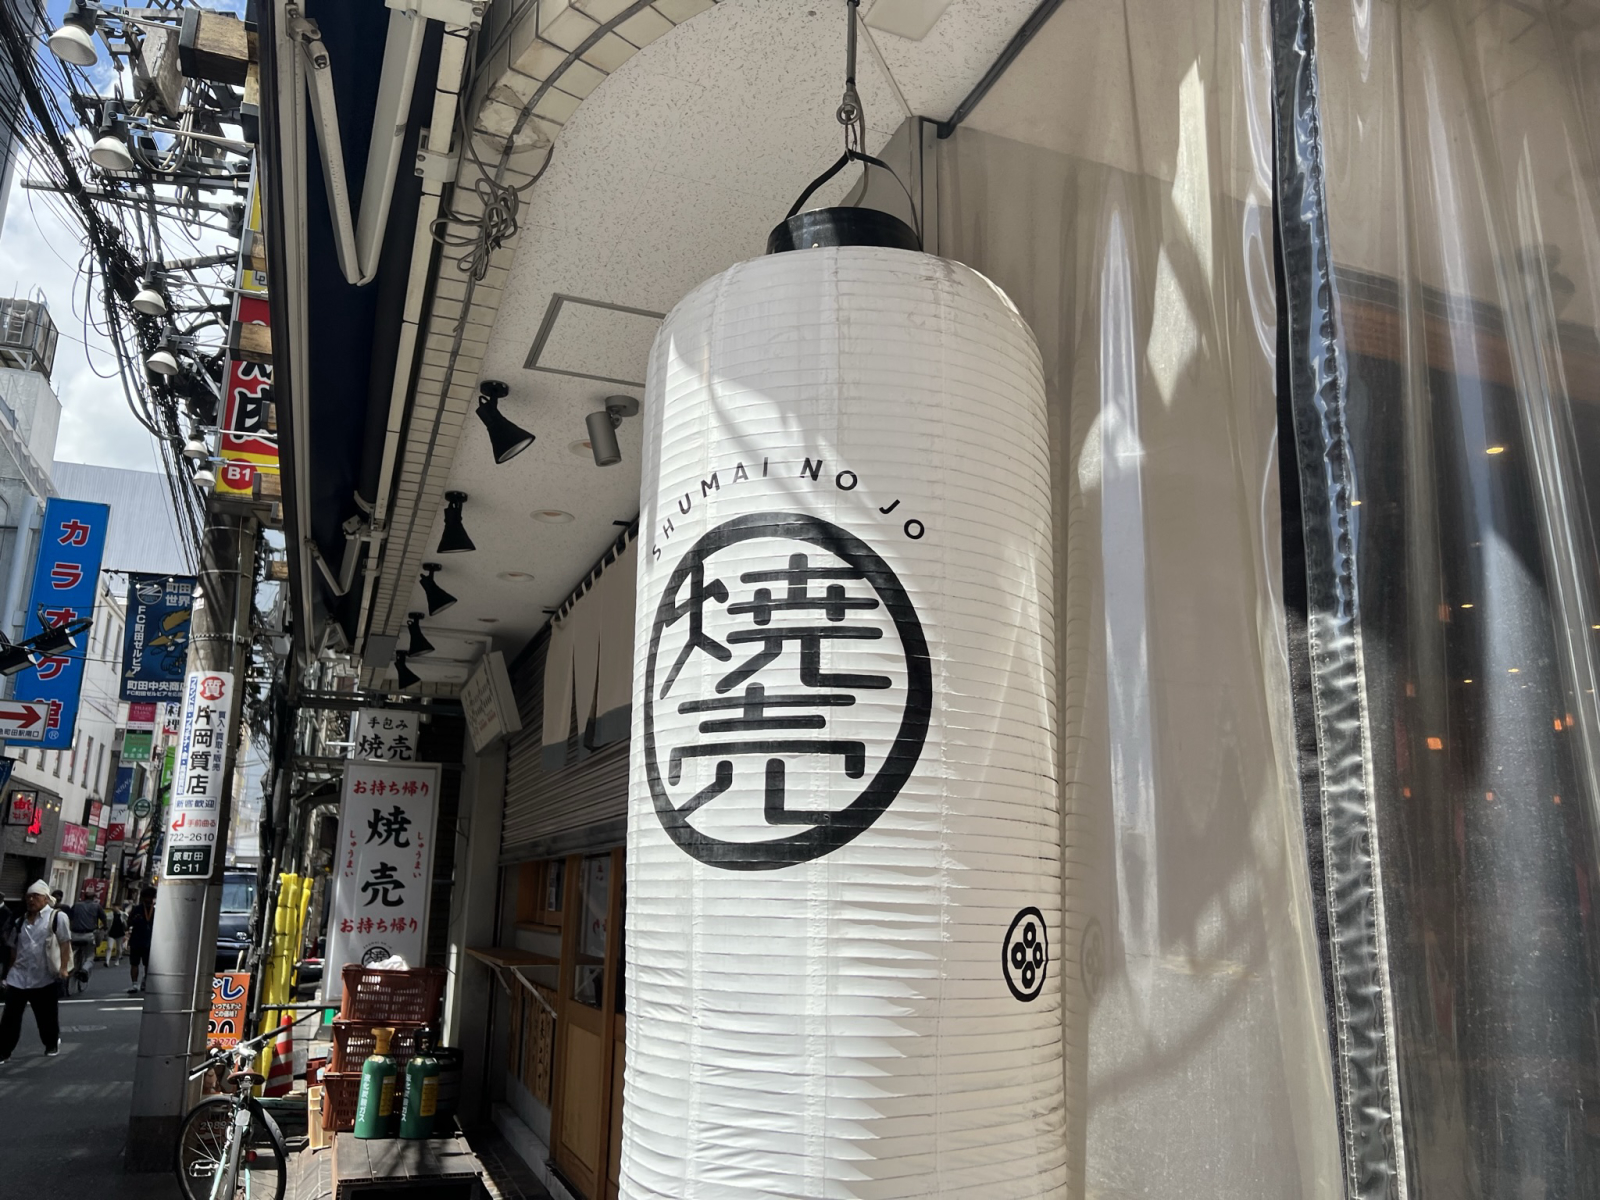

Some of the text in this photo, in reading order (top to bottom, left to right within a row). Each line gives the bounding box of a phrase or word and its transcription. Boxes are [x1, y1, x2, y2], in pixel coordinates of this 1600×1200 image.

[227, 466, 250, 481] B1
[652, 457, 925, 561] SHUMAI NO JO
[166, 583, 191, 593] 町田
[165, 595, 190, 606] 世界
[132, 605, 147, 675] FC町田ゼルビア
[204, 680, 222, 697] 質
[367, 716, 408, 730] 手包み
[186, 705, 216, 795] 片岡質店
[358, 733, 412, 760] 焼売
[353, 780, 429, 797] お持ち帰り
[169, 833, 215, 842] 722-2610
[173, 852, 204, 861] 原町田
[345, 830, 357, 877] しゅうまい
[361, 805, 412, 907] 焼売
[413, 832, 425, 878] しゅうまい
[173, 864, 199, 873] 6-11
[340, 917, 418, 934] お持ち帰り
